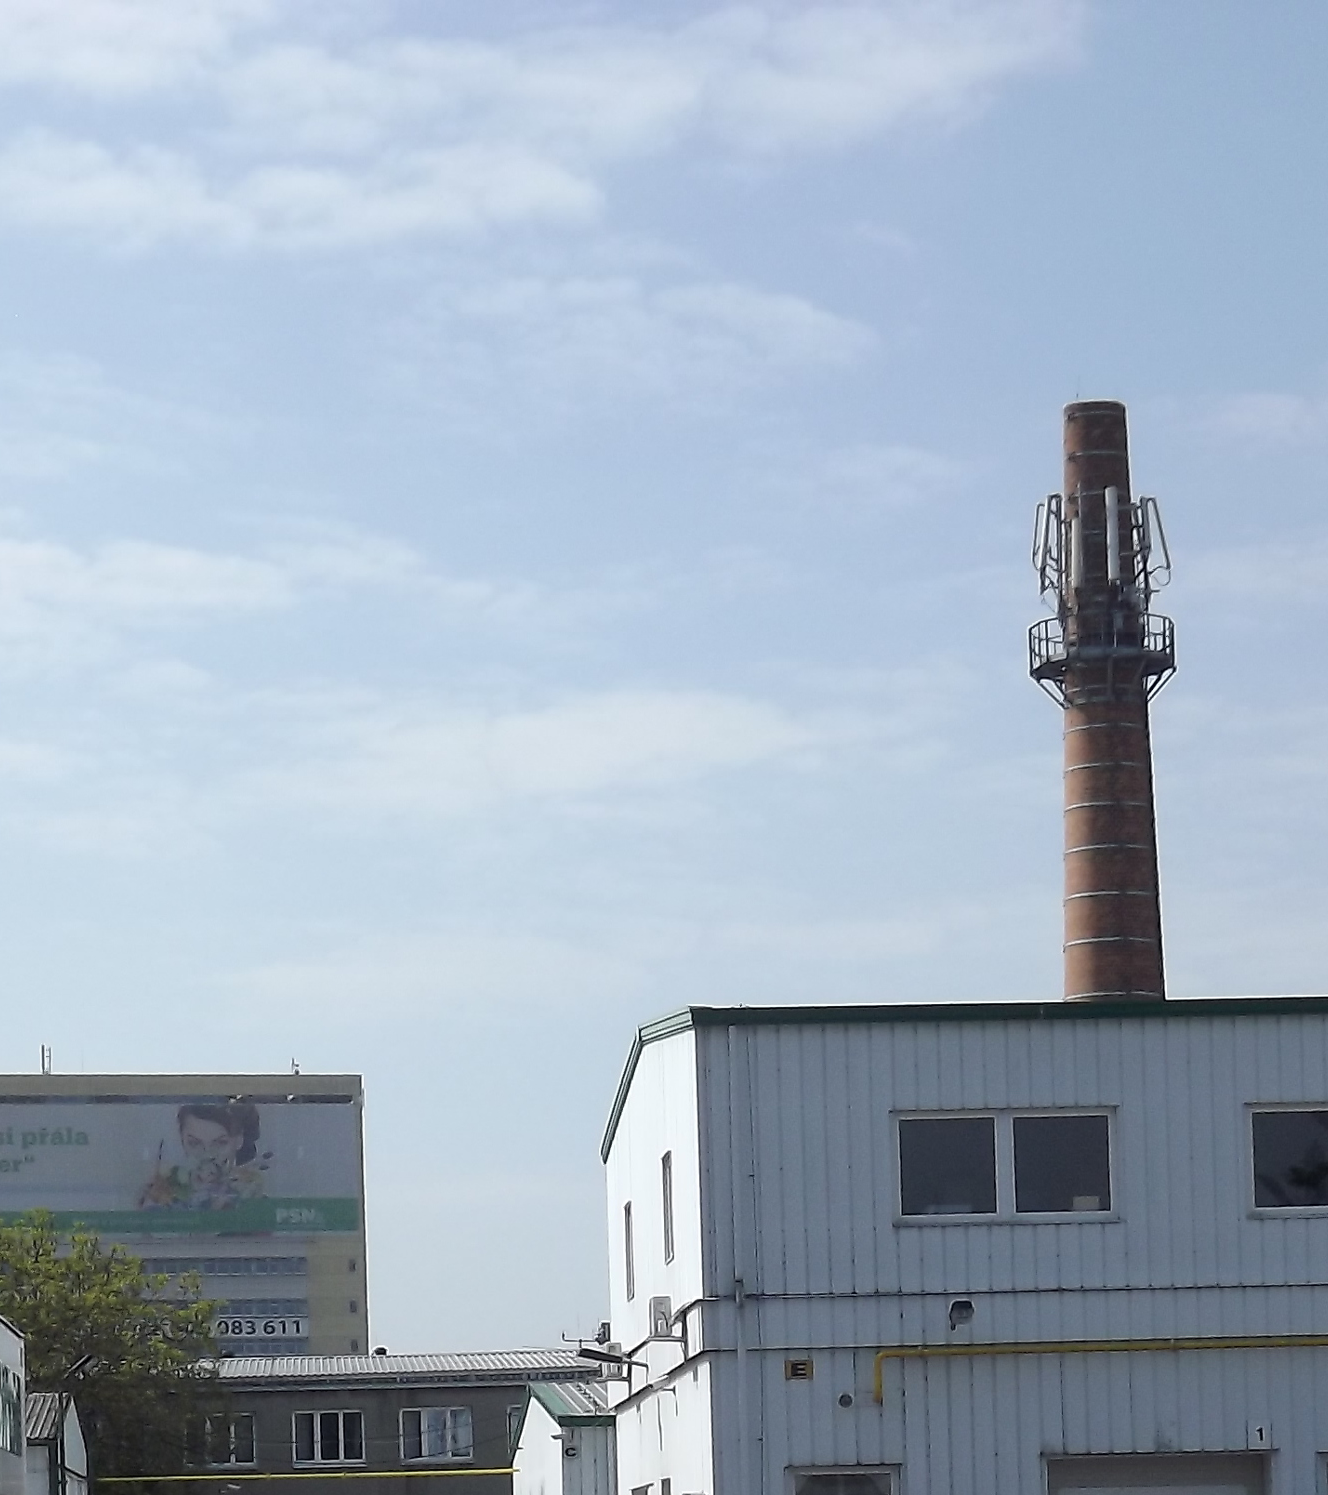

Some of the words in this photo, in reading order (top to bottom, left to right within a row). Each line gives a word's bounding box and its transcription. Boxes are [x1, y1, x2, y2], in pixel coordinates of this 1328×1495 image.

[22, 1127, 89, 1149] přála
[263, 1320, 301, 1335] 611
[791, 1362, 807, 1377] E
